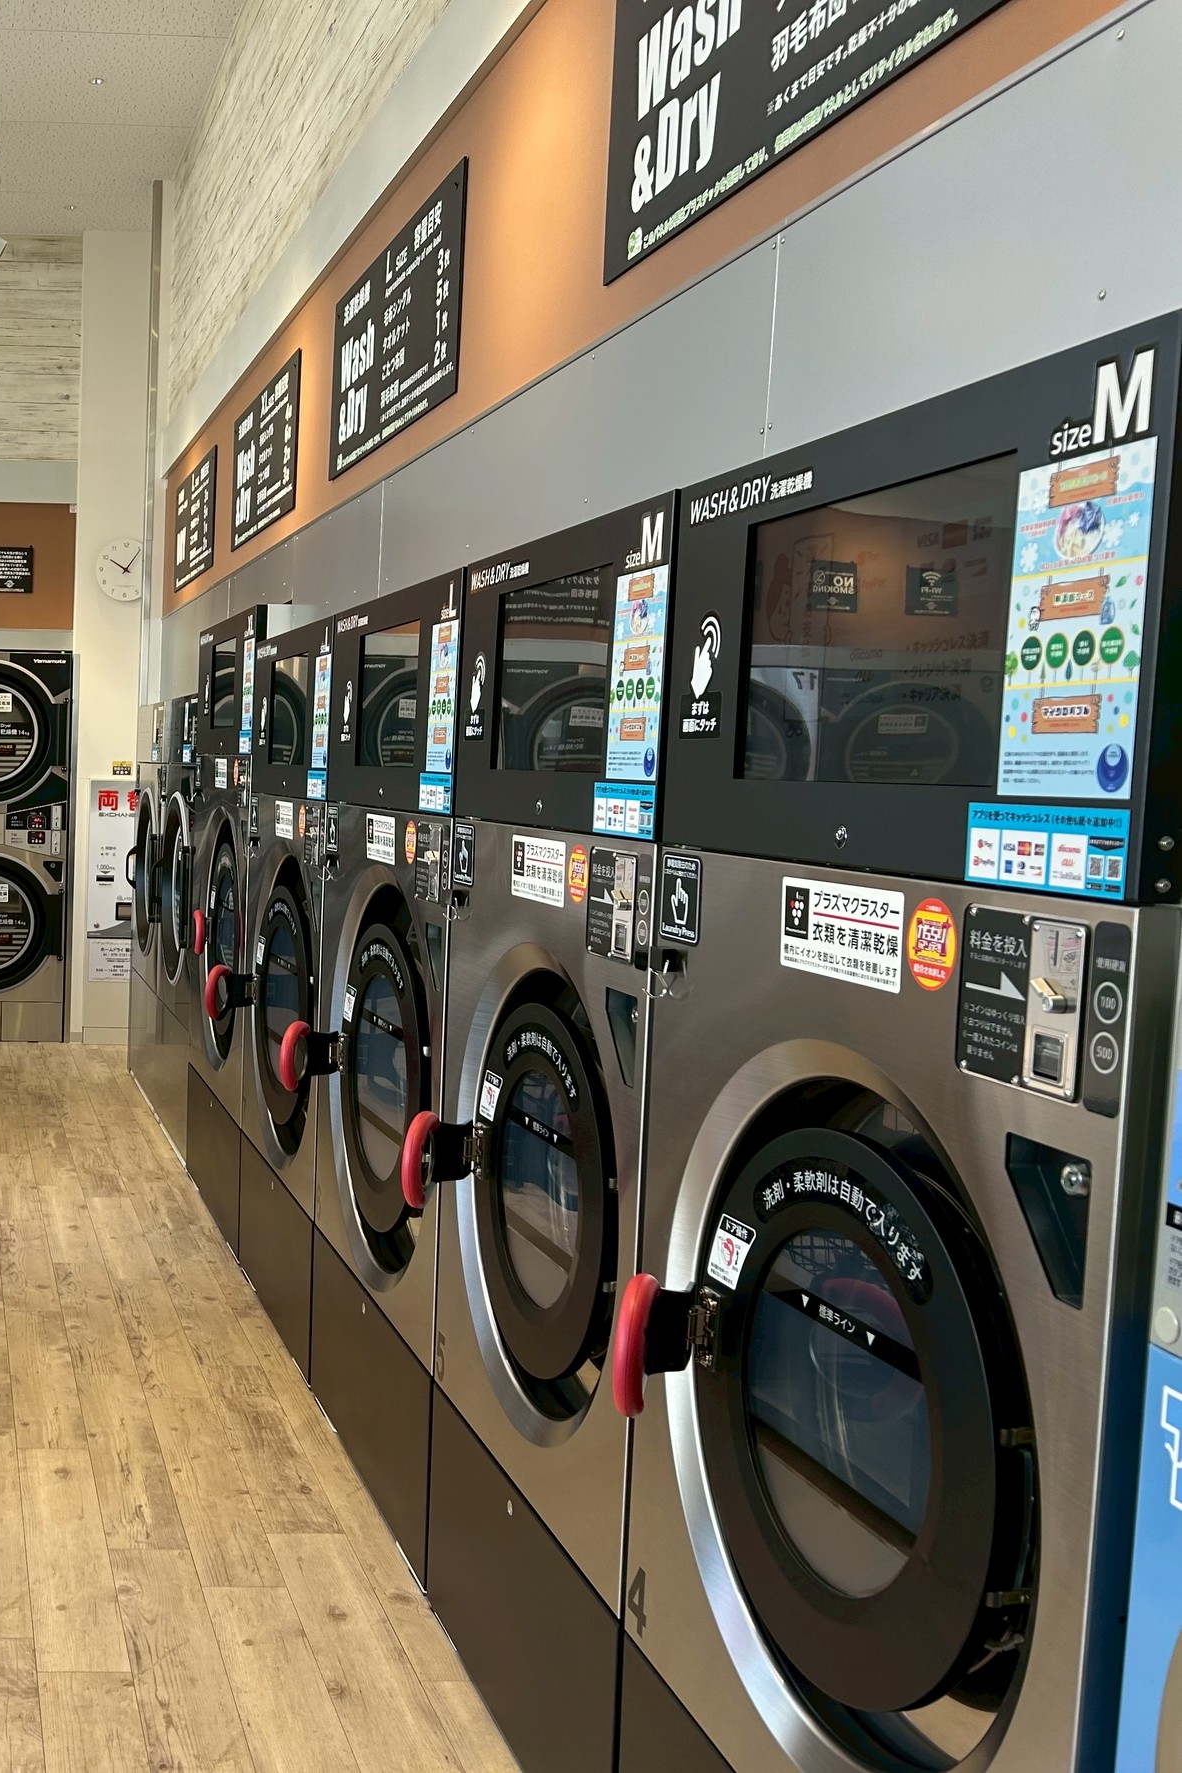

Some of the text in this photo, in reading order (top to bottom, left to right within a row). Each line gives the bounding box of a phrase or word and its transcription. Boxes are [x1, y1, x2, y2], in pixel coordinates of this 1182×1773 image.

[631, 71, 722, 214] &Dry
[385, 250, 393, 284] L
[414, 200, 443, 251] 容量目安
[382, 278, 450, 355] タオルケット 5枚
[383, 247, 451, 327] 毛布シングル 3枚
[340, 317, 376, 393] Wash
[381, 346, 405, 381] こたつ布団
[435, 309, 449, 337] 1枚
[433, 340, 447, 369] 2枚
[338, 383, 369, 446] &Dry
[1050, 348, 1155, 456] size M
[237, 439, 256, 490] Wash
[689, 470, 813, 525] WASH&DRY 洗濯乾燥機
[624, 550, 641, 569] size
[640, 511, 665, 565] M
[526, 843, 564, 860] プラズマクラスター
[662, 922, 695, 938] Laundry Press
[814, 890, 900, 919] プラズマクラスター
[812, 922, 899, 958] 衣類を清潔乾燥
[969, 929, 1028, 958] 料金を投入
[763, 1170, 922, 1282] 洗剤・柔軟剤は自動で入ります
[818, 1304, 856, 1333] 標準ライン
[627, 1566, 647, 1639] 4
